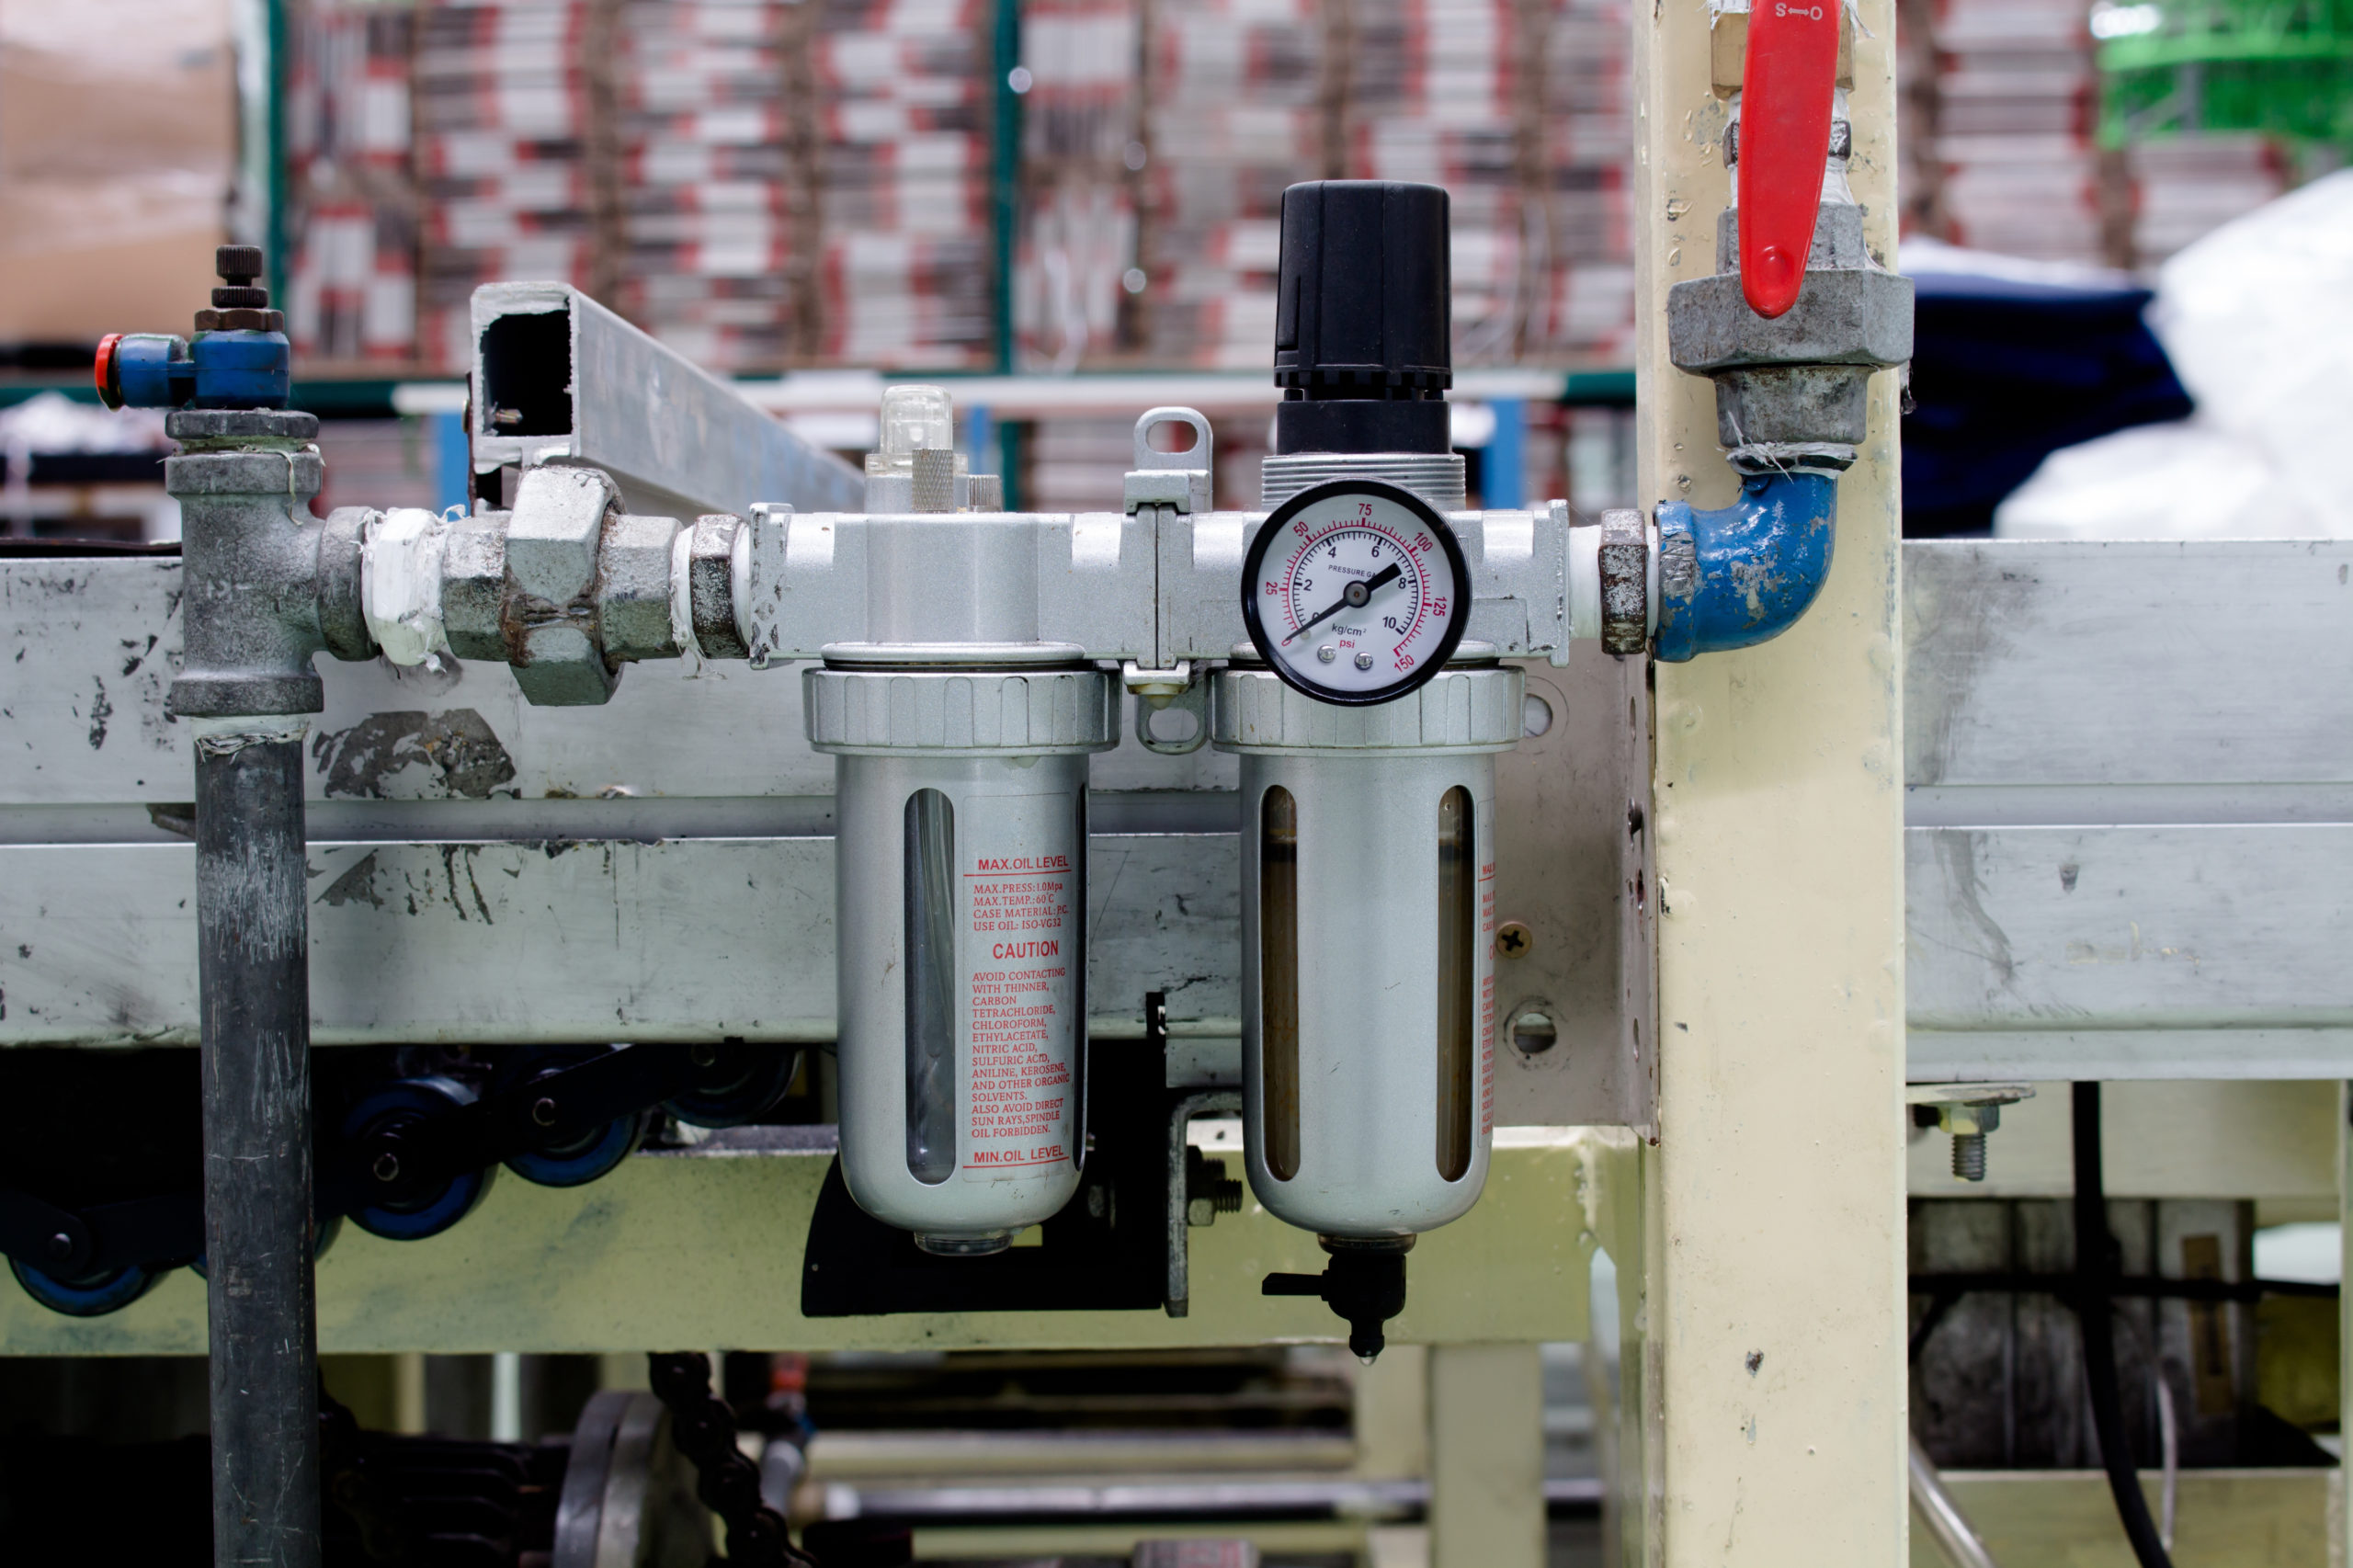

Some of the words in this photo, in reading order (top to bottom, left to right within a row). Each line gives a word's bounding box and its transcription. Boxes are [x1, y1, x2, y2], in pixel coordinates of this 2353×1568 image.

[1775, 3, 1787, 17] S
[1810, 6, 1823, 20] O
[1358, 503, 1372, 517] 75
[1292, 521, 1309, 539] 50
[1414, 531, 1433, 553] 100
[1328, 546, 1336, 559] 4
[1371, 546, 1380, 558] 6
[1328, 564, 1366, 577] PRESSURE
[1266, 581, 1278, 596] 25
[1303, 579, 1312, 592] 2
[1398, 577, 1406, 590] 8
[1433, 596, 1448, 617] 125
[1382, 616, 1396, 629] 10
[1339, 639, 1356, 650] psi
[1393, 655, 1415, 673] 150
[978, 857, 1034, 870] MAX.OIL
[1036, 855, 1069, 869] LEVEL
[972, 909, 1001, 919] CASE
[972, 921, 995, 931] USE
[997, 921, 1019, 931] OIL:
[1022, 918, 1062, 929] ISO-VG32
[993, 940, 1059, 959] CAUTION
[972, 971, 1006, 982] AVOID
[1008, 967, 1066, 980] CONTACTING
[972, 984, 1001, 994] WITH
[1004, 982, 1050, 993] THINNER,
[972, 996, 1017, 1006] CARBON
[972, 1006, 1056, 1018] TETRACHLORIDE,
[972, 1018, 1047, 1030] CHLOROFORM,
[972, 1030, 1049, 1042] ETHYLACETATE,
[972, 1044, 1009, 1053] NITRIC
[1012, 1043, 1038, 1052] ACID,
[972, 1056, 1024, 1066] SULFURIC
[1027, 1054, 1051, 1063] ACID,
[972, 1068, 1018, 1078] ANILINE,
[1020, 1062, 1067, 1075] KEROSENE,
[972, 1081, 995, 1090] AND
[998, 1079, 1032, 1089] OTHER
[1035, 1074, 1070, 1086] ORGANIC
[972, 1092, 1028, 1102] SOLVENTS.
[972, 1106, 999, 1114] ALSO
[1002, 1103, 1033, 1112] AVOID
[1035, 1098, 1064, 1111] DIRECT
[971, 1117, 995, 1126] SUN
[971, 1129, 991, 1138] OIL
[993, 1125, 1051, 1137] FORBIDDEN.
[973, 1151, 1027, 1163] MIN.OIL
[1030, 1145, 1064, 1159] LEVEL
